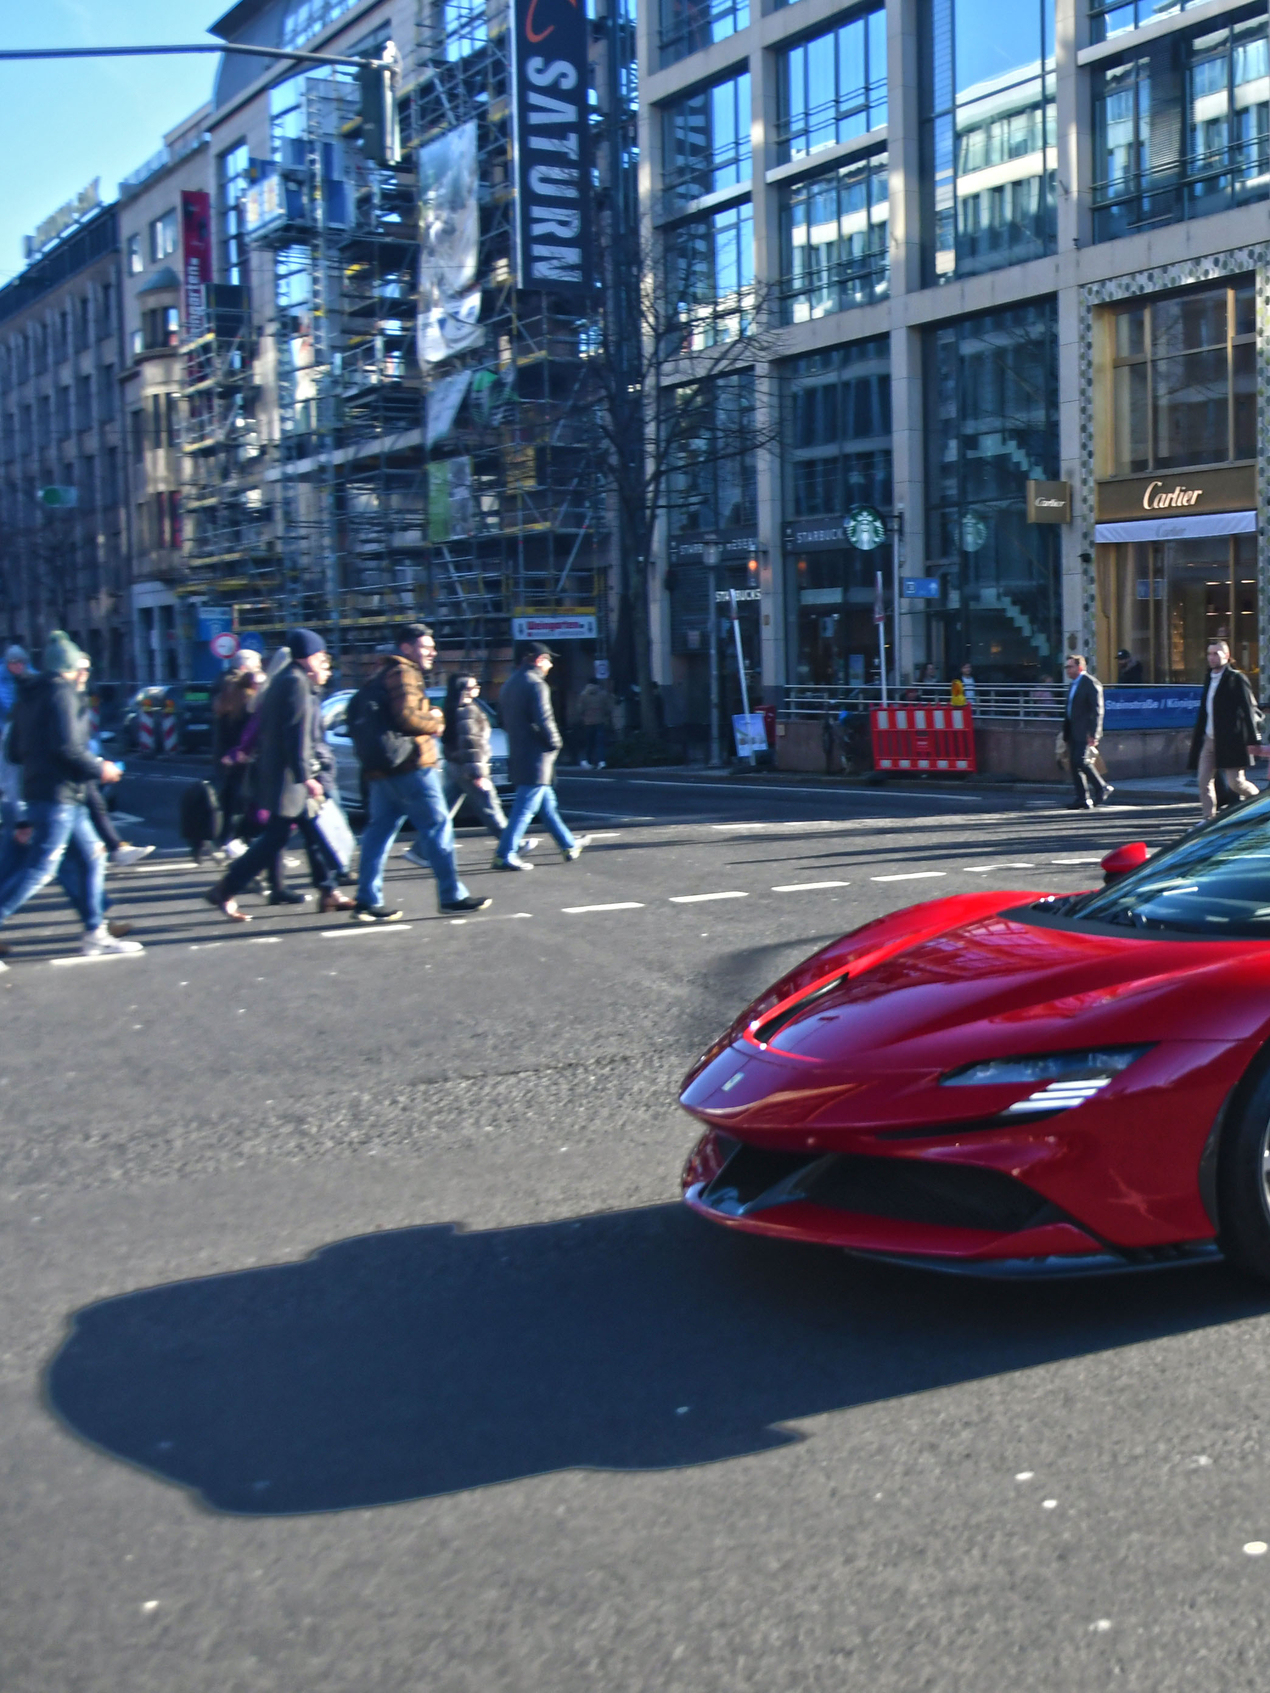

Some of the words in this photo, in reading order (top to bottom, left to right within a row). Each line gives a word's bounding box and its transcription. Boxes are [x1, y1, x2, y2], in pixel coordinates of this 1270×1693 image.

[525, 55, 583, 282] SATURN
[1142, 480, 1203, 510] Cartier
[1034, 497, 1067, 508] Cartier
[715, 589, 761, 602] STABUCKS
[1105, 699, 1159, 709] Steinstraße
